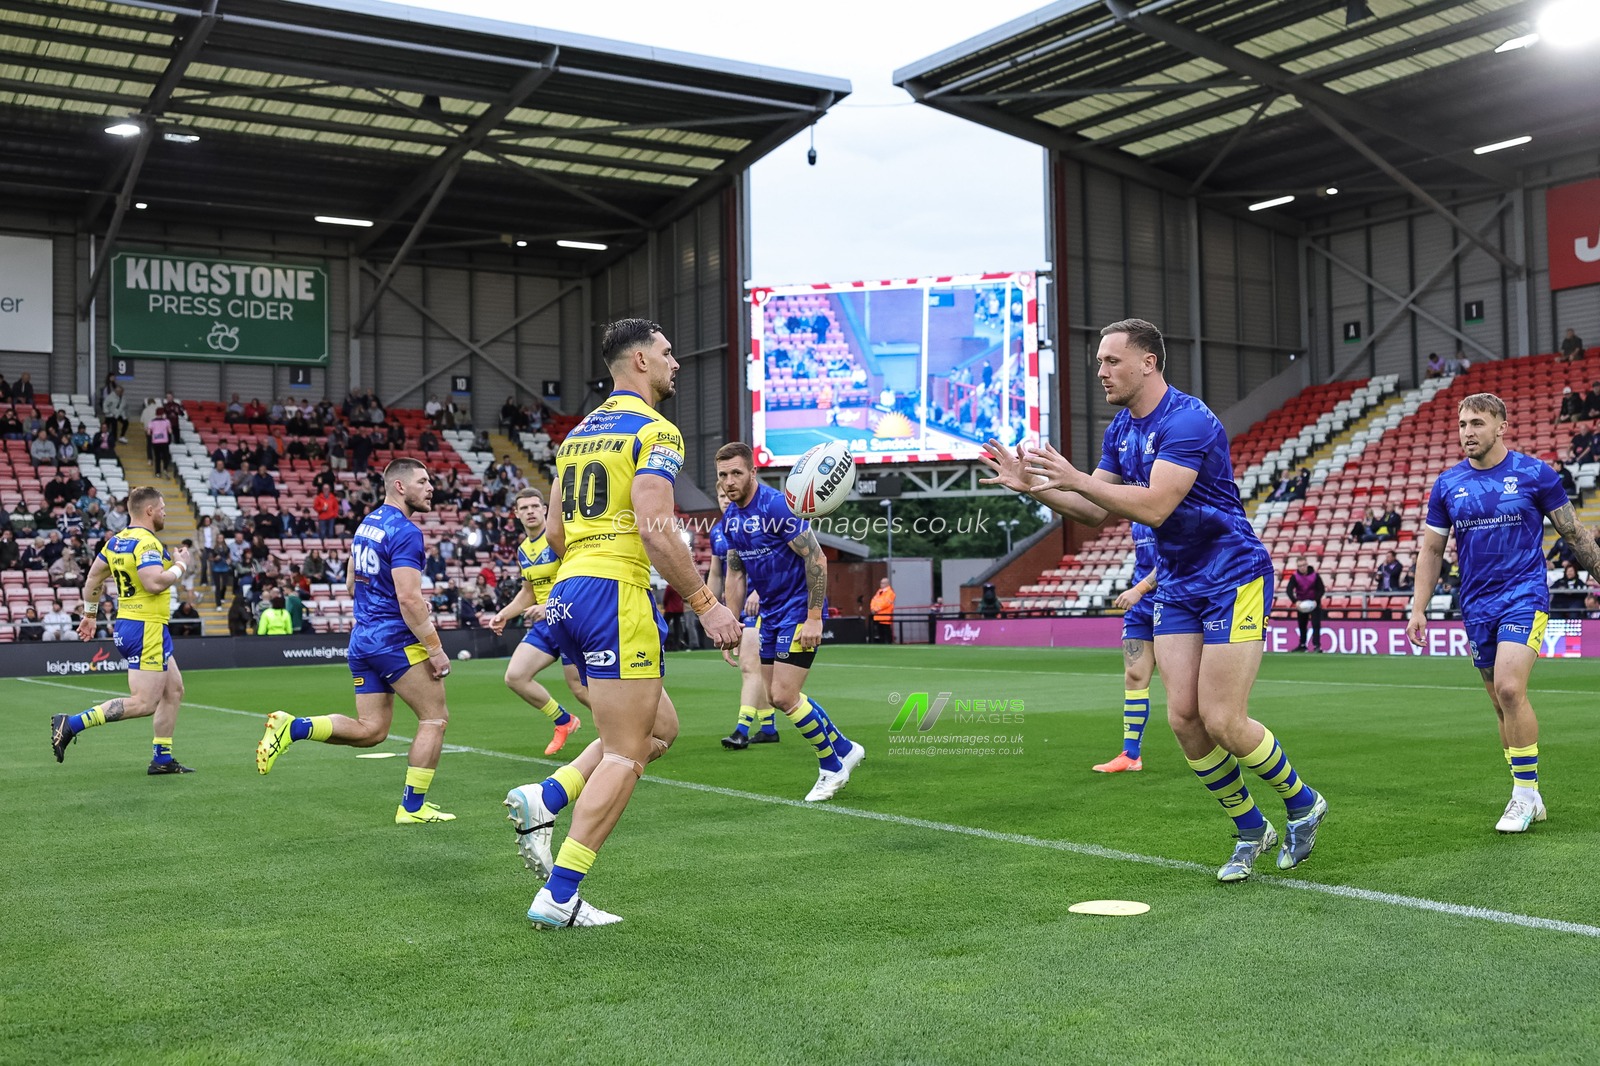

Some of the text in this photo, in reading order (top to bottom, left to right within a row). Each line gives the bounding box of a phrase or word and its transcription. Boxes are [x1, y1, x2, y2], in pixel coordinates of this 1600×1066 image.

[126, 258, 315, 300] KINGSTONE
[149, 294, 294, 321] PRESS CIDER
[1471, 304, 1477, 317] 1
[118, 360, 127, 375] 9
[456, 378, 467, 391] 10
[547, 383, 555, 395] K
[557, 439, 627, 458] ATTERSON
[815, 451, 853, 502] STEEDEN
[562, 460, 611, 524] 40
[858, 480, 877, 494] SHOT
[1463, 513, 1522, 526] Birchwood Park
[113, 570, 136, 598] 13
[46, 658, 129, 675] leighsportsvill
